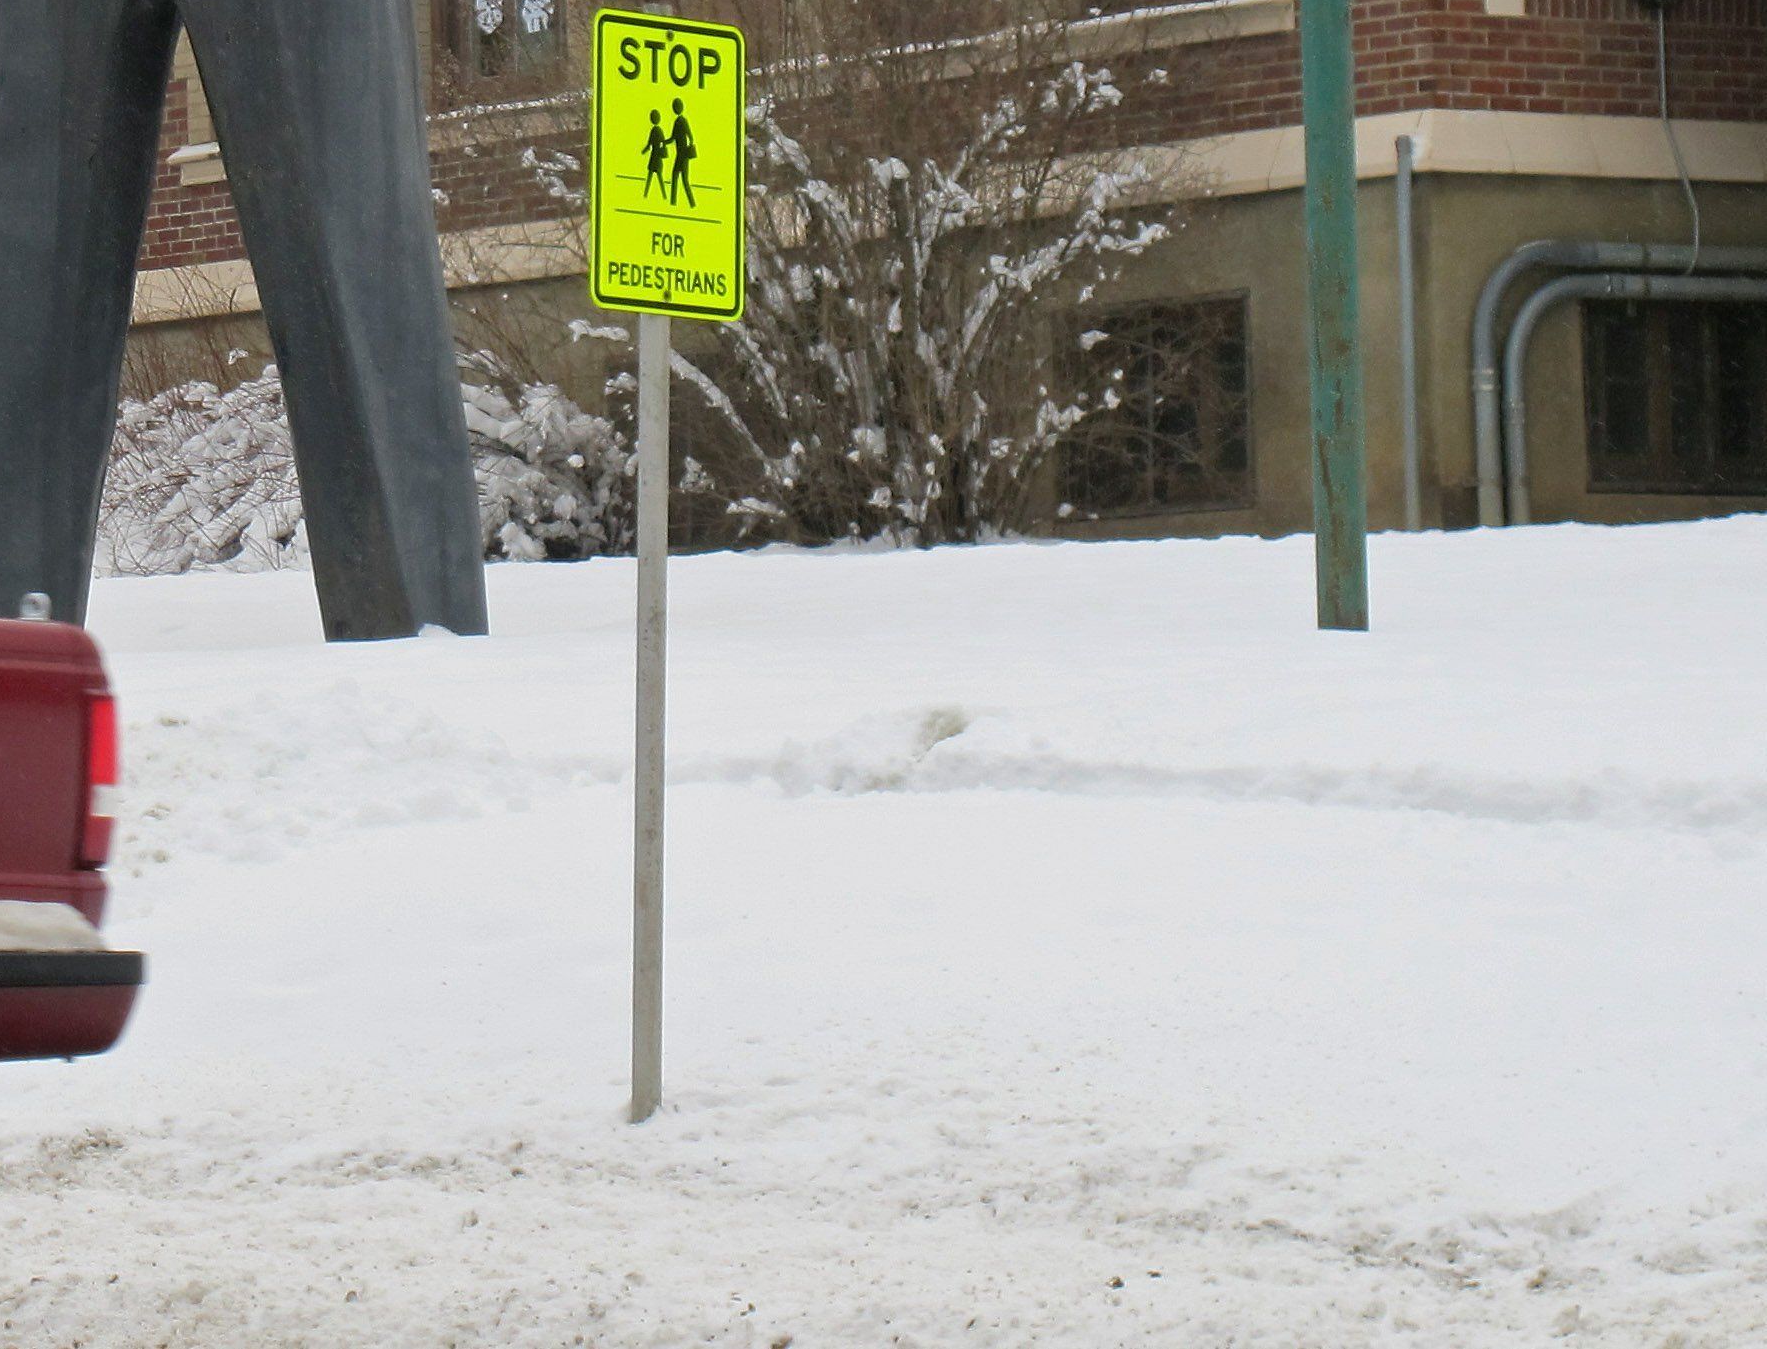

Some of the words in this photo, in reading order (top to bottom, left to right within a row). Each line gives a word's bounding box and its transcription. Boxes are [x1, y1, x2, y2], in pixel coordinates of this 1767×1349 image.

[618, 37, 722, 90] STOP
[652, 231, 685, 258] FOR
[608, 261, 727, 297] PEDESTRIANS
